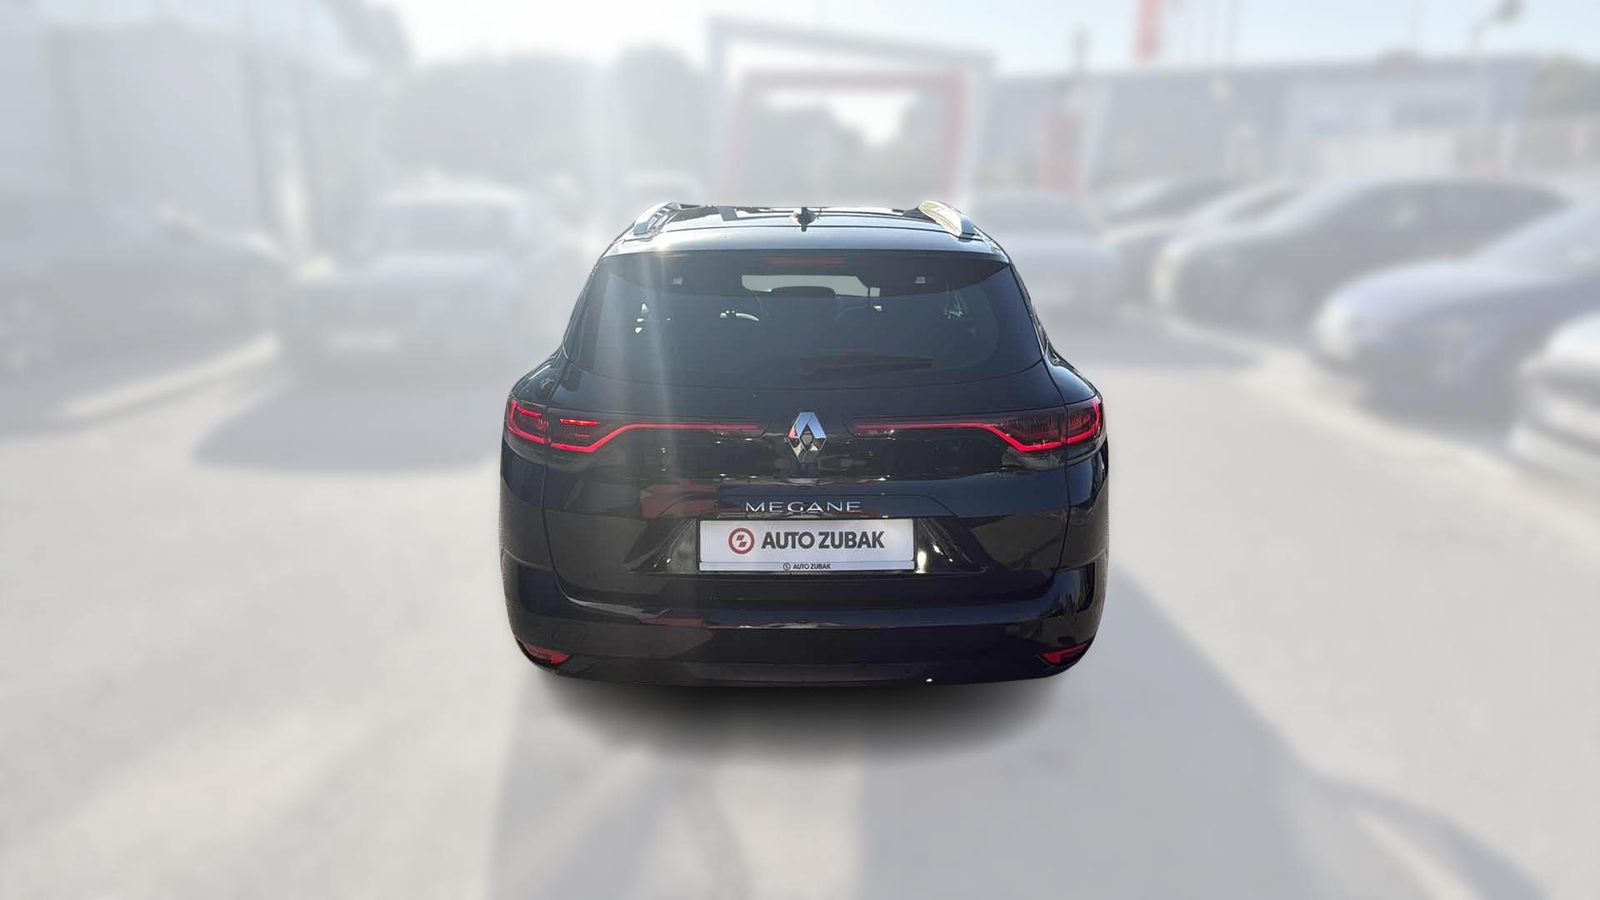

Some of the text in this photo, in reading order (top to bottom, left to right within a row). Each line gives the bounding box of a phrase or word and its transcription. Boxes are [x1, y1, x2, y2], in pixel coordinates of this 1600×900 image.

[746, 501, 861, 513] MEGANE
[761, 531, 884, 549] AUTO ZUBAK
